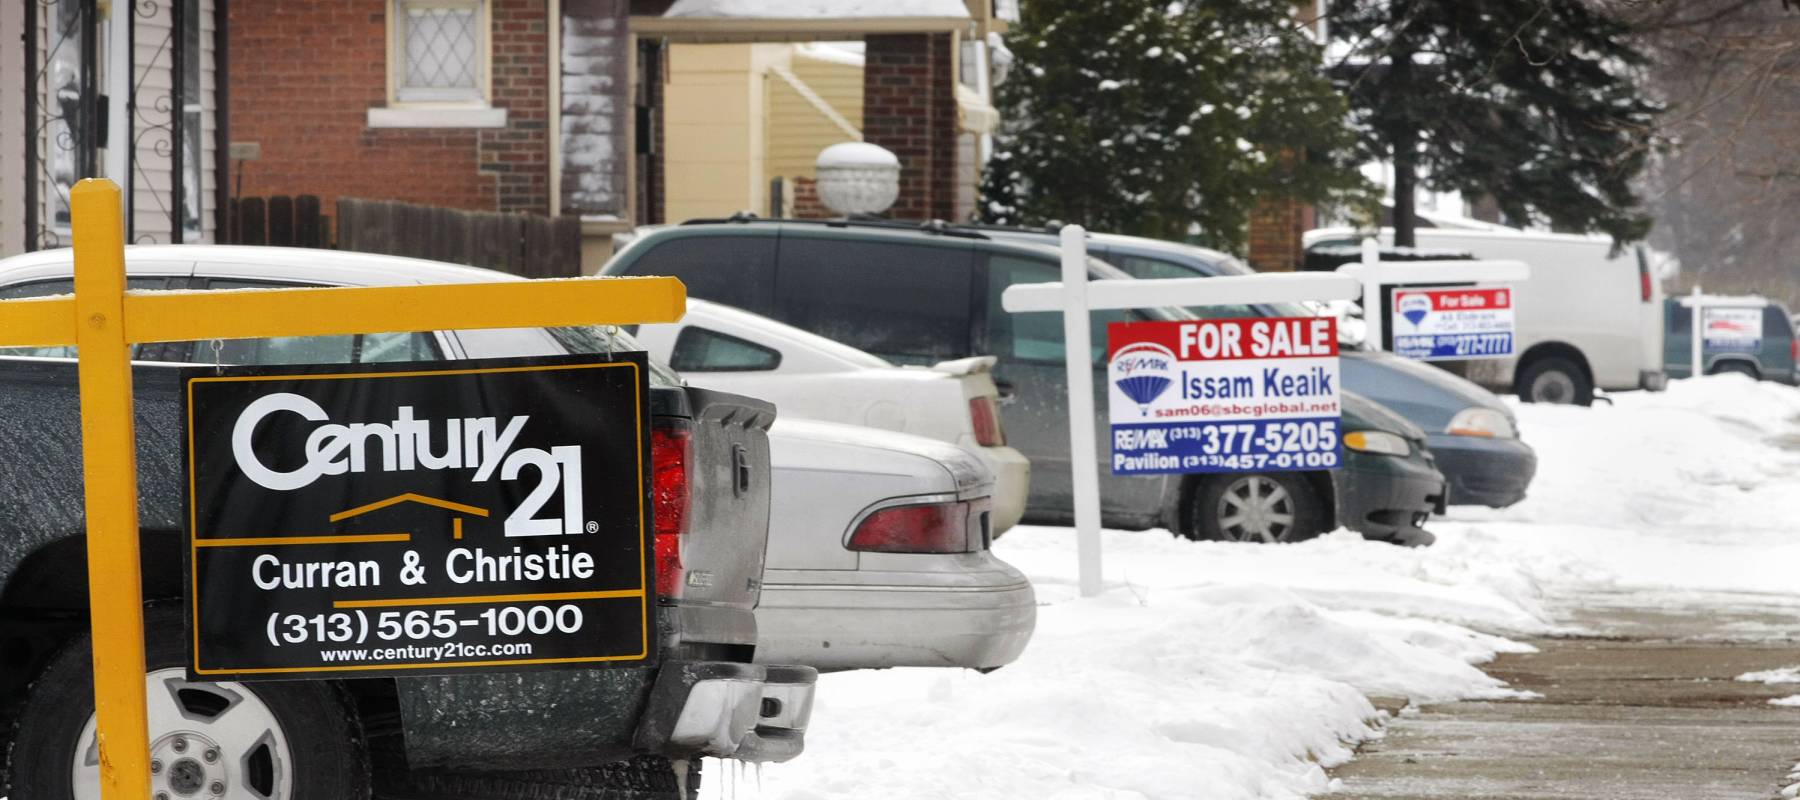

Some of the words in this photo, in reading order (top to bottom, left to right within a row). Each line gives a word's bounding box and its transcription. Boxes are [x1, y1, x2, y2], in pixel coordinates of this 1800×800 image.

[1440, 294, 1459, 308] For
[1460, 293, 1485, 307] Sale
[1179, 322, 1242, 358] FOR
[1251, 320, 1331, 356] SALE
[1181, 369, 1253, 400] Issam
[1263, 366, 1332, 397] Keaik
[1155, 401, 1338, 418] sam06@sbcglobal.net
[232, 392, 530, 491] Century
[1114, 428, 1169, 450] RE/MAX
[1170, 426, 1201, 442] (313)
[1202, 420, 1337, 455] 377-5205
[1114, 453, 1180, 470] Pavilion
[252, 553, 380, 591] Curran
[400, 549, 426, 586] &
[446, 543, 595, 585] Christie
[266, 608, 369, 648] (313)
[377, 604, 584, 640] 565-1000
[321, 641, 533, 663] www.century21cc.com
